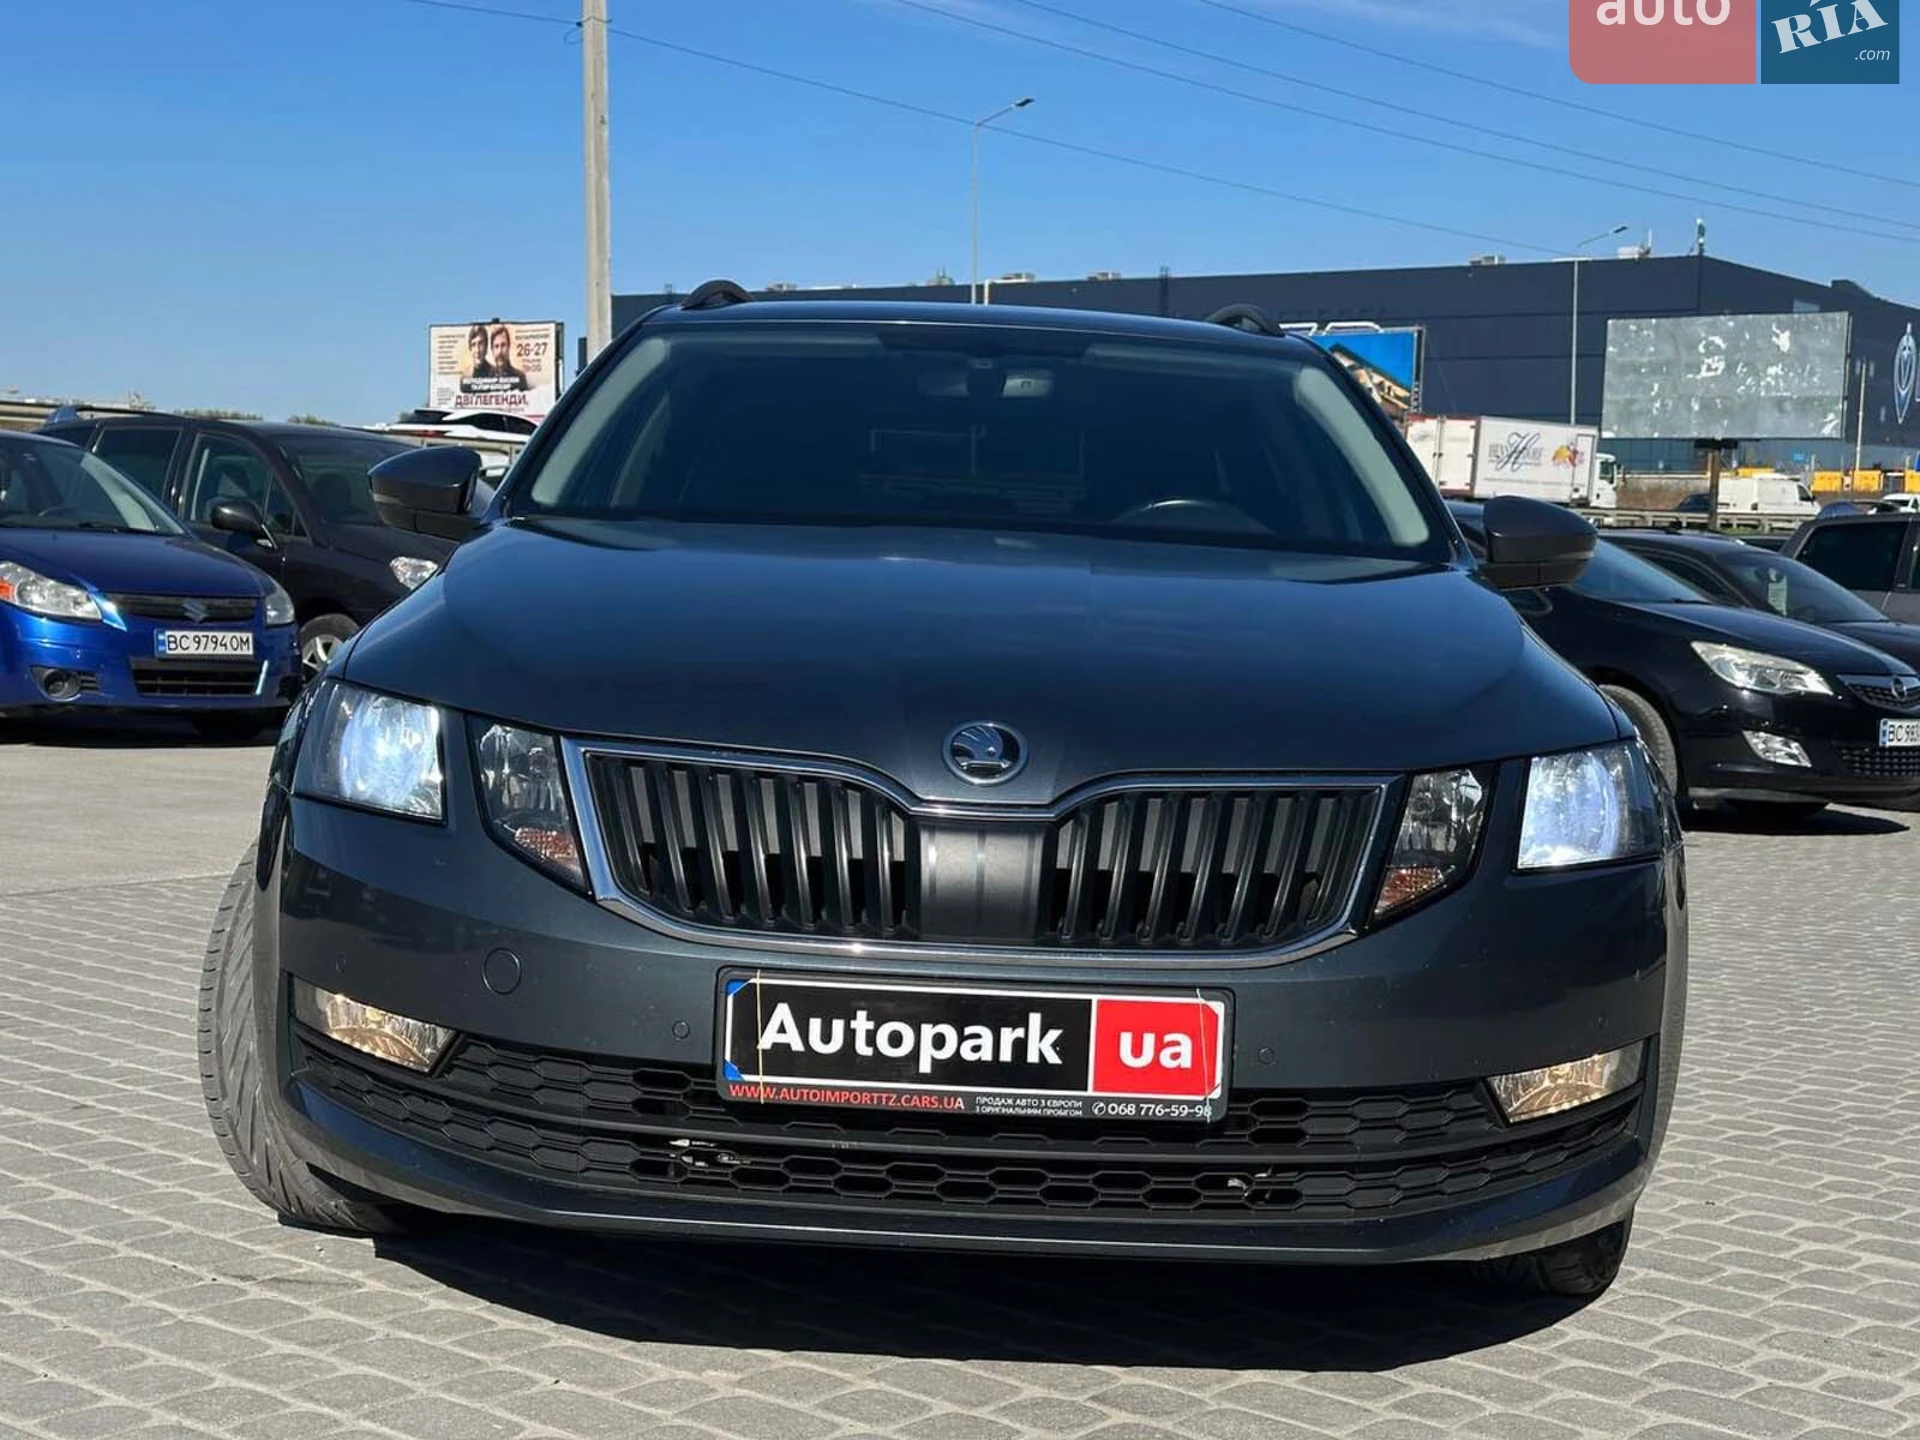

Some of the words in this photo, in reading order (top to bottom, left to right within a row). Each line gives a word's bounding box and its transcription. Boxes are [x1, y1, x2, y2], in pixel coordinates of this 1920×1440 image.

[516, 342, 548, 357] 26-27
[758, 1002, 1063, 1073] Autopark
[1118, 1029, 1193, 1069] ua
[1015, 1098, 1039, 1106] АВТО
[1107, 1103, 1136, 1116] 068
